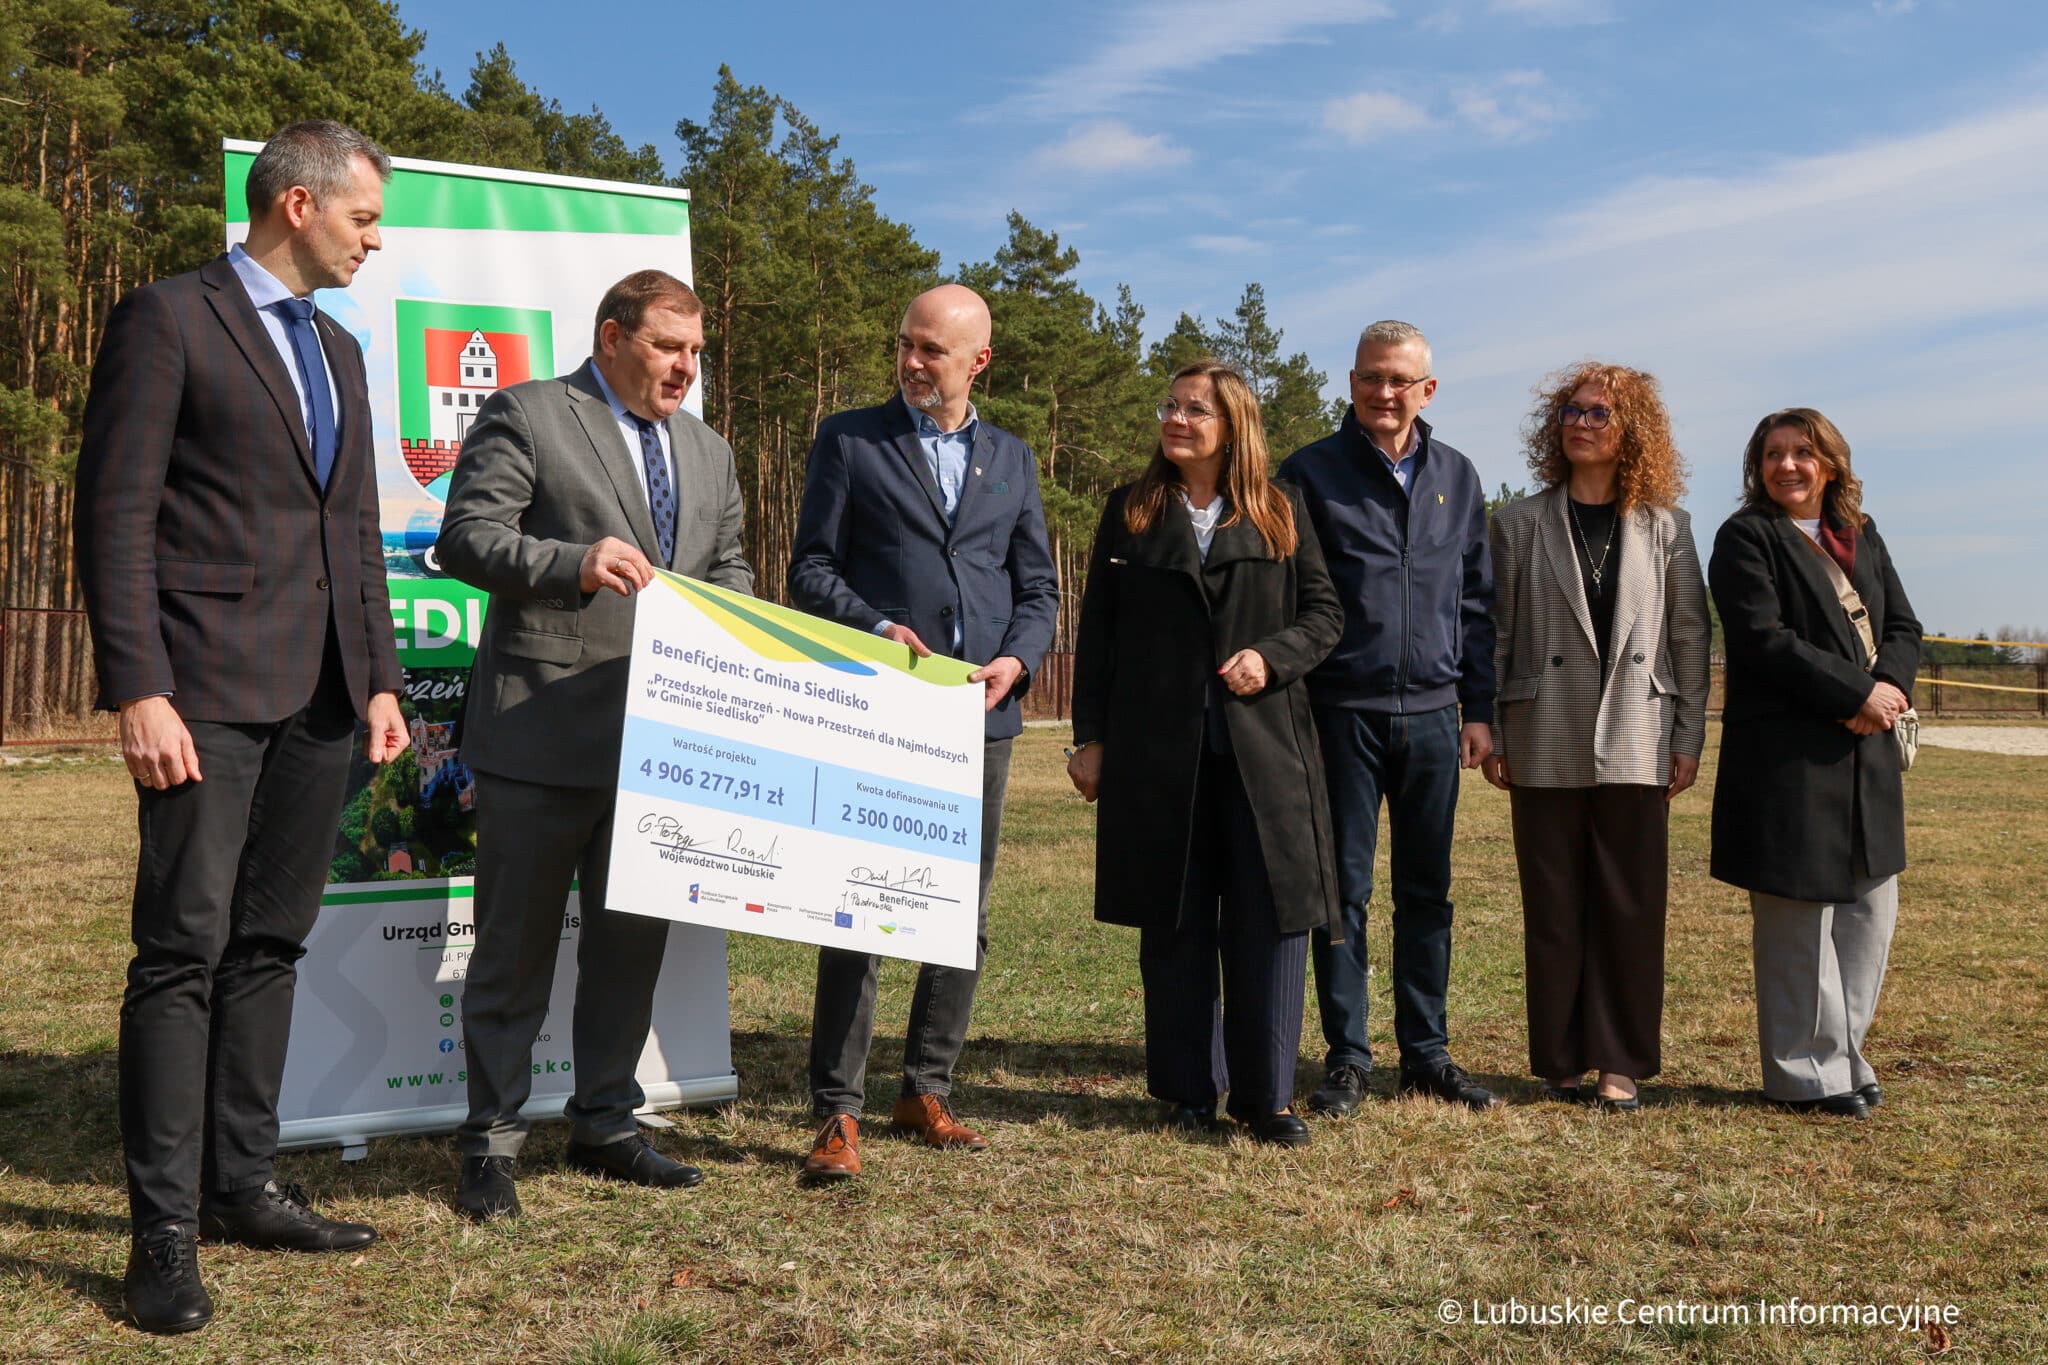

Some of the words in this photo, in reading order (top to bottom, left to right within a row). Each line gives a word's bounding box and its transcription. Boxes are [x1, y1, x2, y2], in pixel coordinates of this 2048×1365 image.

[652, 639, 749, 679] Beneficjent:
[753, 667, 800, 693] Gmina
[804, 682, 869, 711] Siedlisko
[646, 688, 657, 698] w
[660, 690, 703, 710] Gminie
[731, 695, 773, 714] marzeń
[783, 707, 814, 725] Nowa
[817, 716, 875, 741] Przestrzeń
[878, 732, 895, 746] dla
[897, 737, 969, 764] Najmłodszych
[673, 737, 714, 756] Wartość
[715, 748, 757, 766] projektu
[640, 758, 652, 777] 4
[658, 761, 694, 786] 906
[699, 771, 761, 800] 277,91
[767, 787, 784, 807] zł
[856, 782, 884, 796] Kwota
[886, 789, 946, 811] dofinasowania
[948, 804, 959, 814] UE
[841, 804, 852, 822] 2
[857, 807, 888, 829] 500
[893, 815, 948, 841] 000,00
[952, 828, 967, 846] zł
[659, 849, 730, 872] Województwo
[732, 863, 775, 880] Lubuskie
[879, 893, 929, 911] Beneficjent
[382, 922, 442, 943] Urząd
